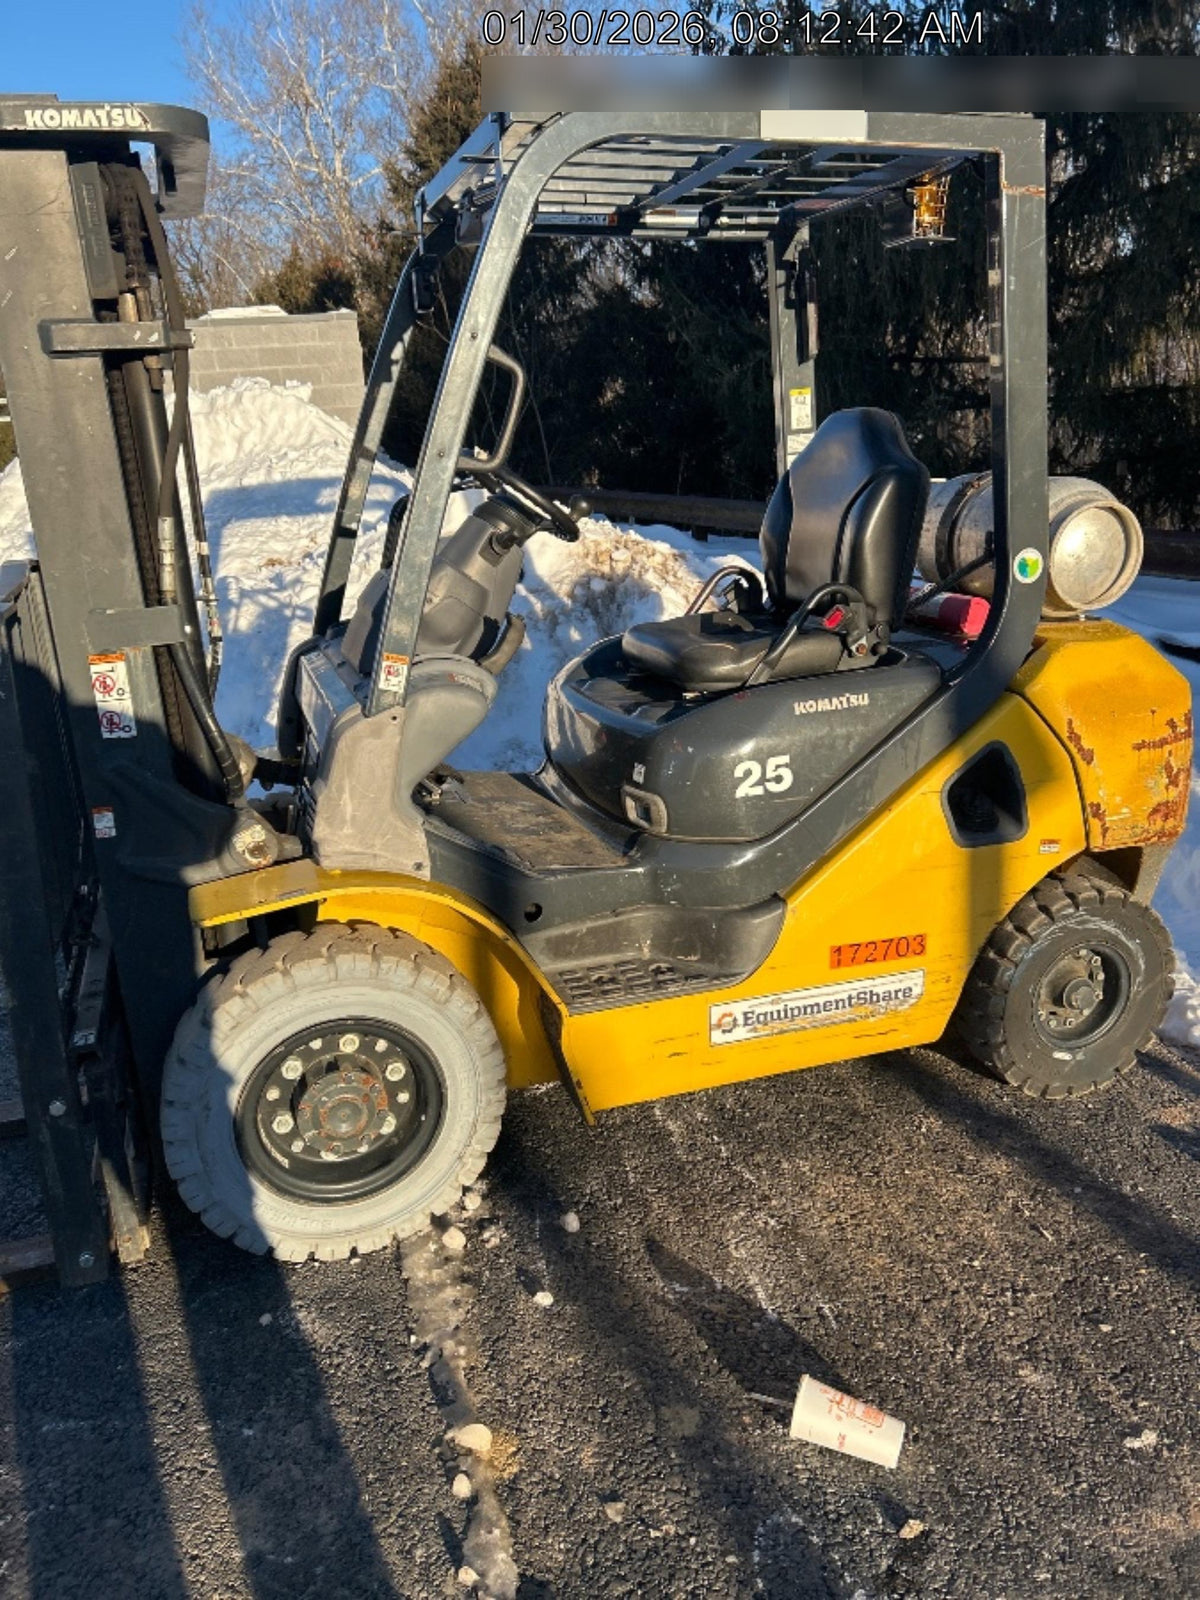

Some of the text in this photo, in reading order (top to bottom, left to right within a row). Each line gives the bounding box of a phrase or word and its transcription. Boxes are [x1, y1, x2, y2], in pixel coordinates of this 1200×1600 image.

[24, 105, 144, 128] KOMATSU
[793, 693, 870, 715] KOMATSU
[733, 754, 794, 799] 25
[832, 934, 926, 967] 172703
[742, 984, 913, 1028] EquipmentShare
